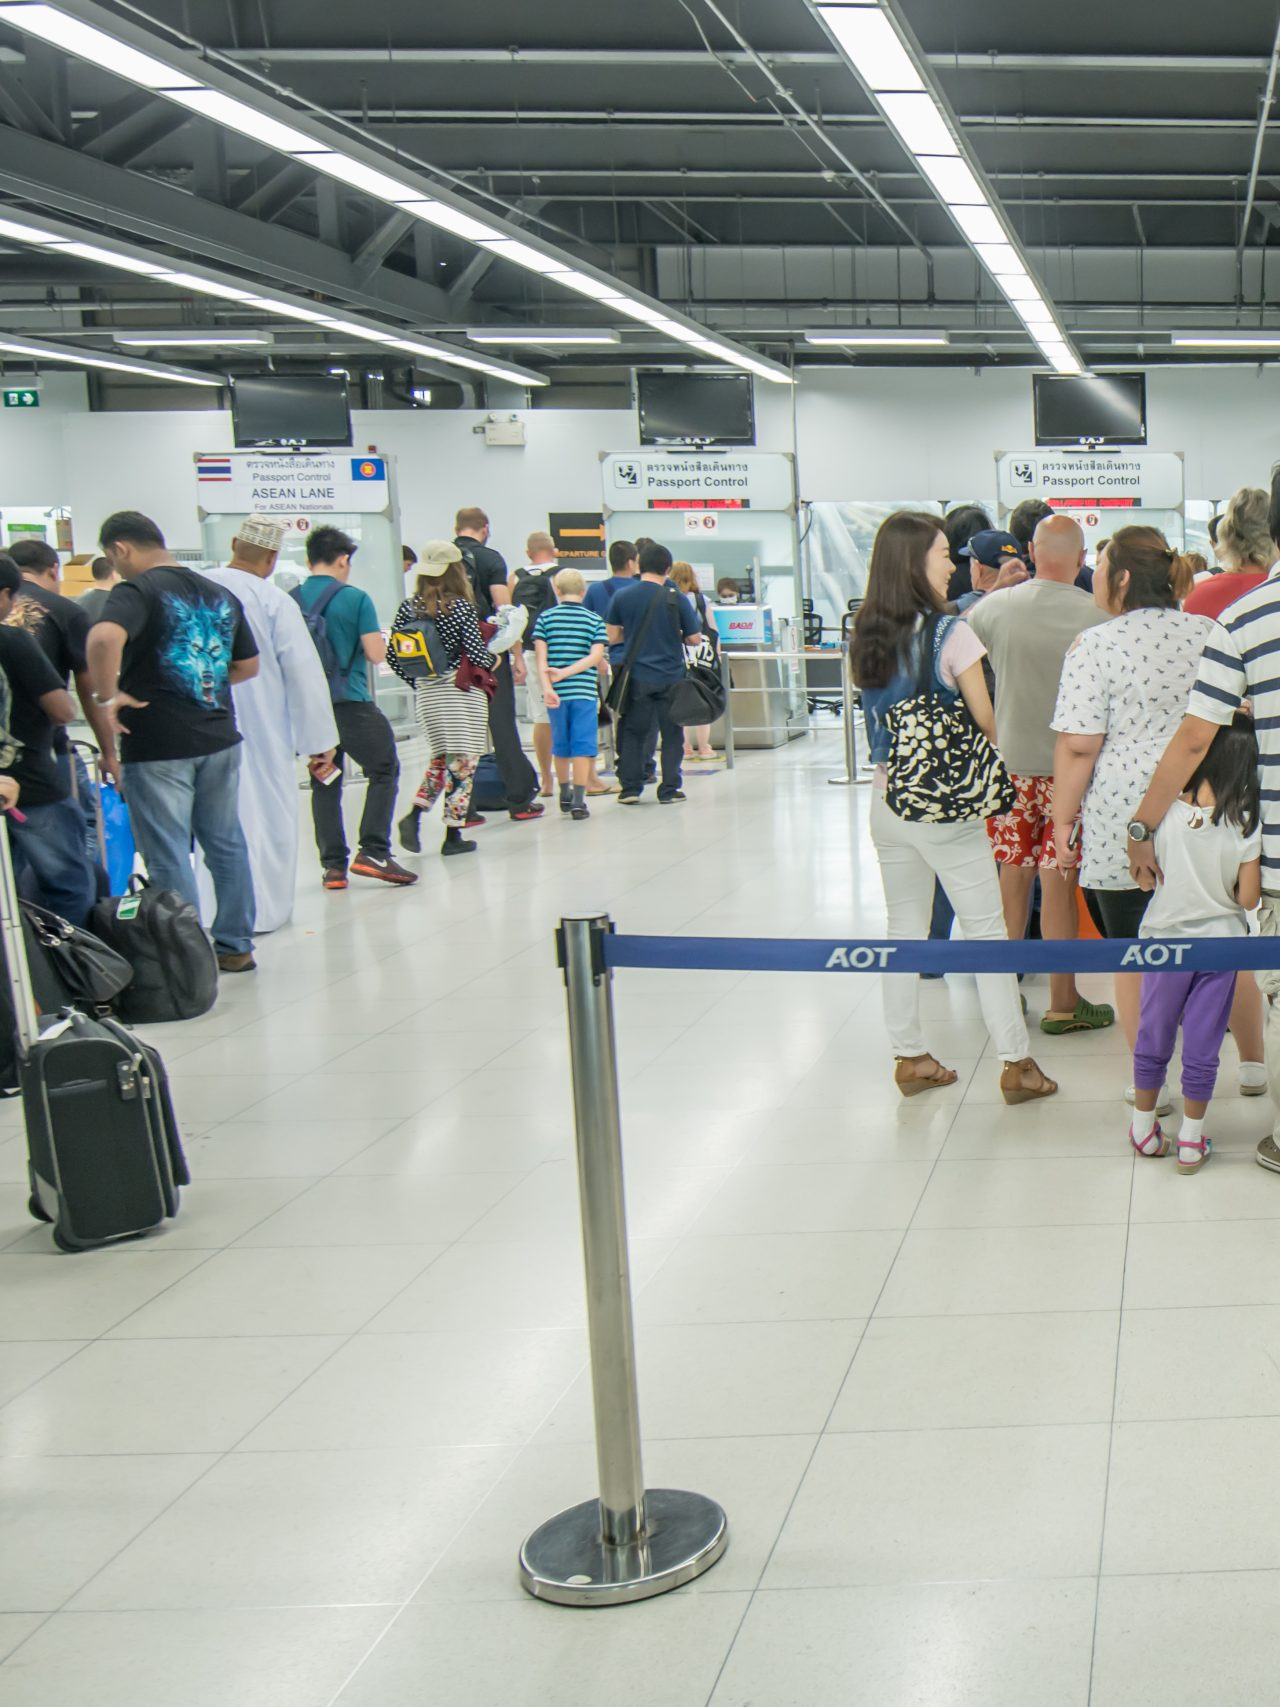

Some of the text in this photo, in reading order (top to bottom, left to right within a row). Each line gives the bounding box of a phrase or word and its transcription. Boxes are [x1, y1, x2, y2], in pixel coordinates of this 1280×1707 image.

[647, 461, 748, 472] ตรวจหนังสือเดินทาง
[1042, 460, 1141, 471] ตรวจหนังสือเดินทาง
[252, 473, 331, 483] Passport Control
[647, 477, 748, 489] Passport Control
[1043, 475, 1140, 487] Passport Control
[252, 488, 335, 499] ASEAN LANE
[824, 946, 898, 968] AOT
[1120, 943, 1193, 965] AOT
